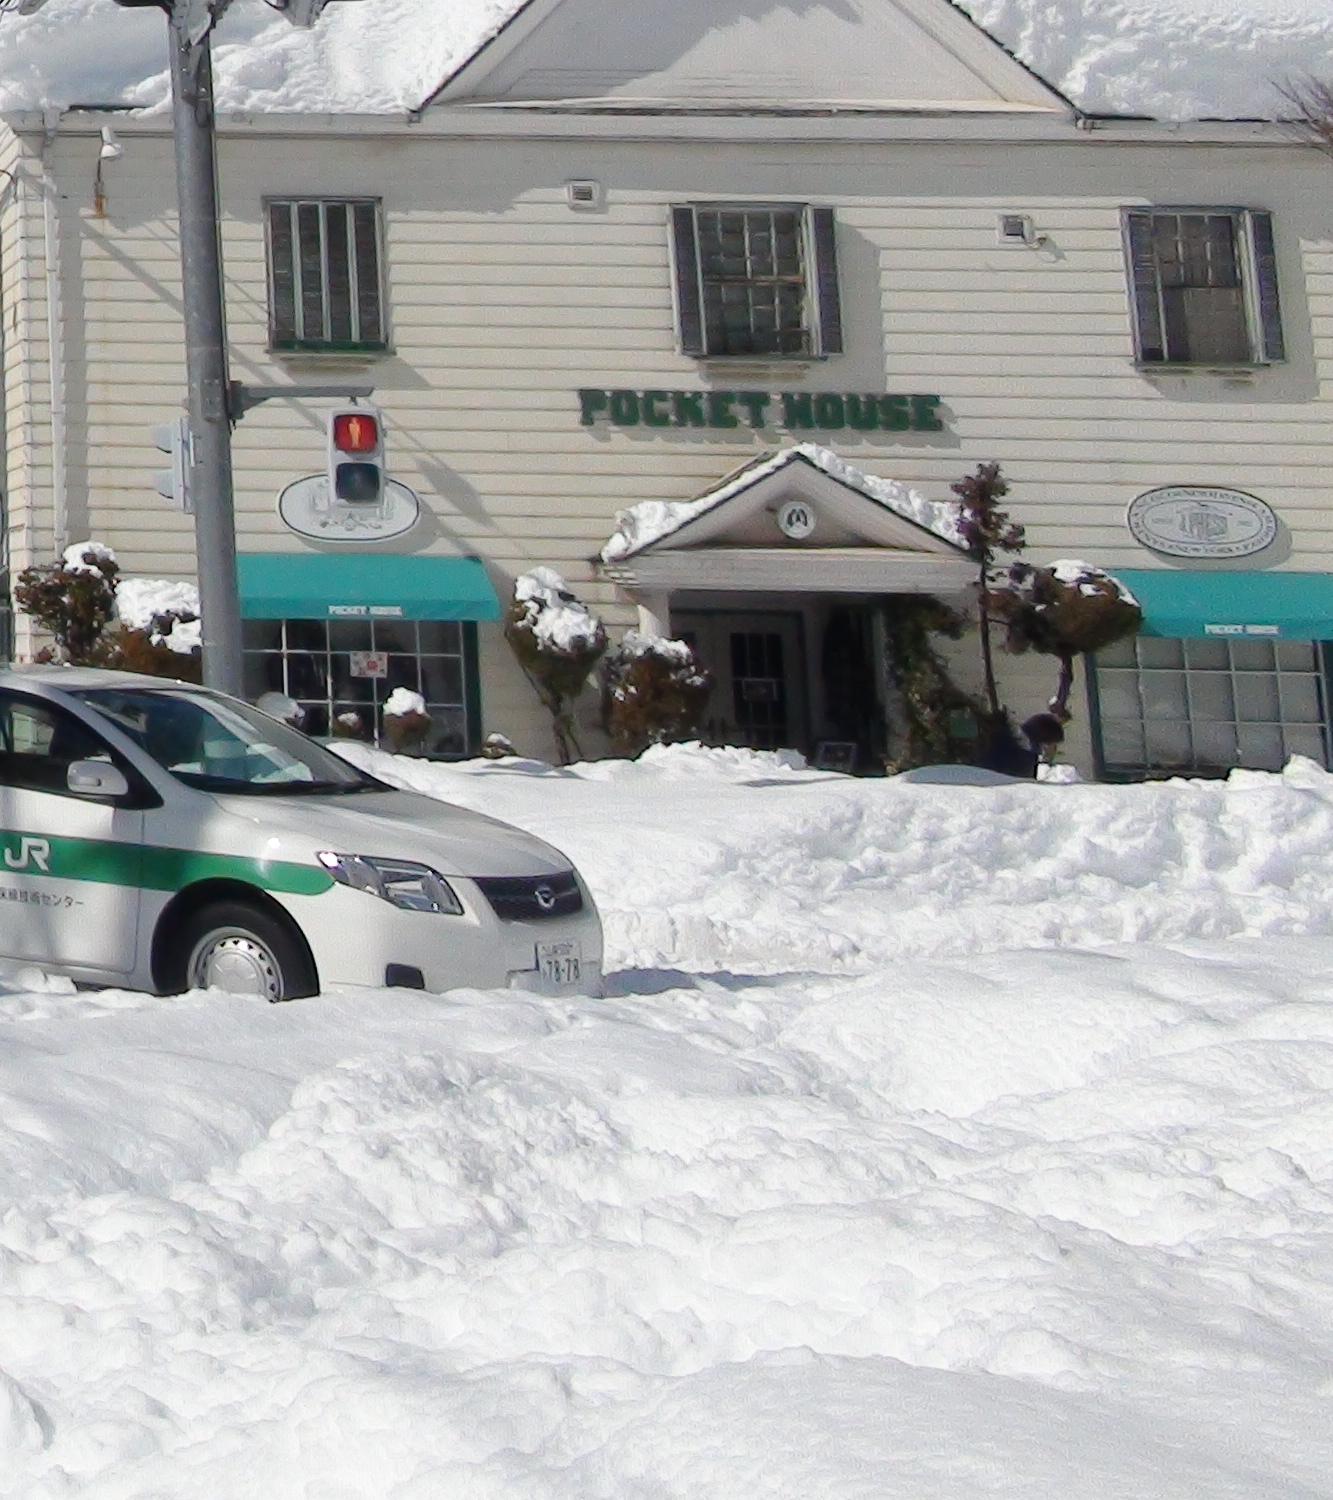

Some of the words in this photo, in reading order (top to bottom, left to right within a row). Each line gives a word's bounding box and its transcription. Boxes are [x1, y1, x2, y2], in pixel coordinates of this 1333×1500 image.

[580, 389, 771, 429] POCKET
[782, 392, 943, 431] HOUSE
[4, 836, 51, 872] JR
